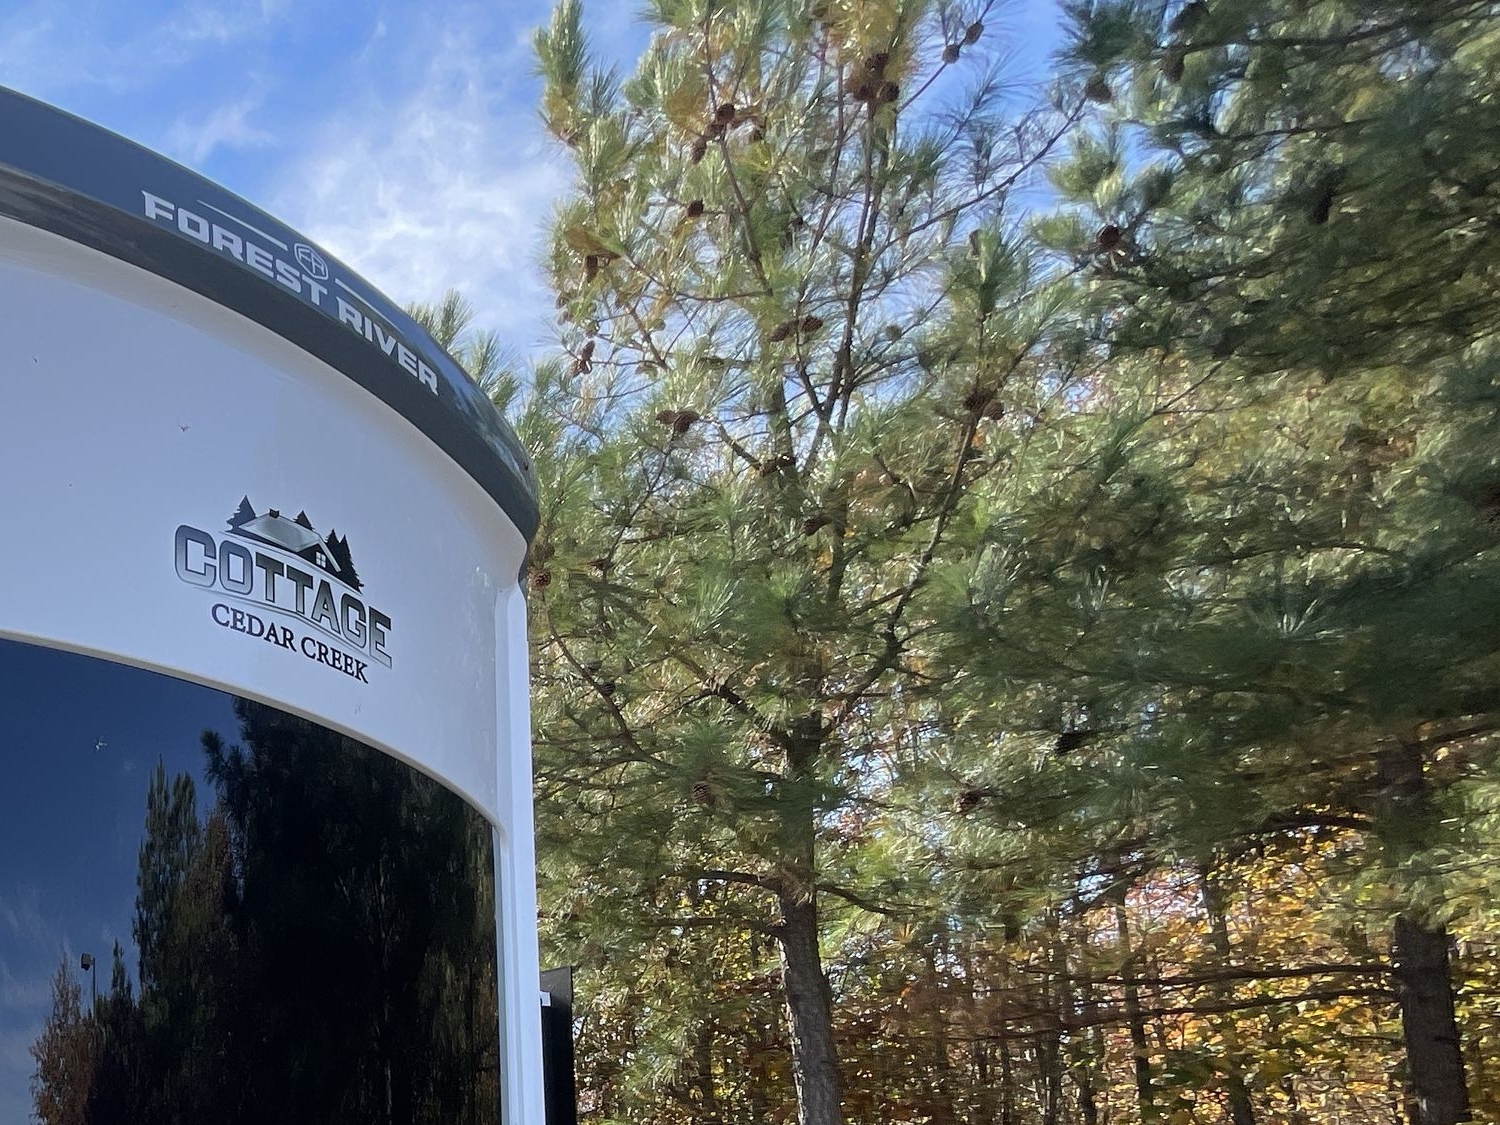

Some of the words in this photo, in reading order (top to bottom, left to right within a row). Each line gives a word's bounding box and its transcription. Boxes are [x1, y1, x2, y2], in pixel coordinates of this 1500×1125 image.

[141, 190, 327, 305] FOREST
[336, 296, 439, 396] RIVER
[174, 524, 393, 669] COTTAGE
[211, 603, 297, 652] CEDAR
[300, 636, 369, 684] CREEK
